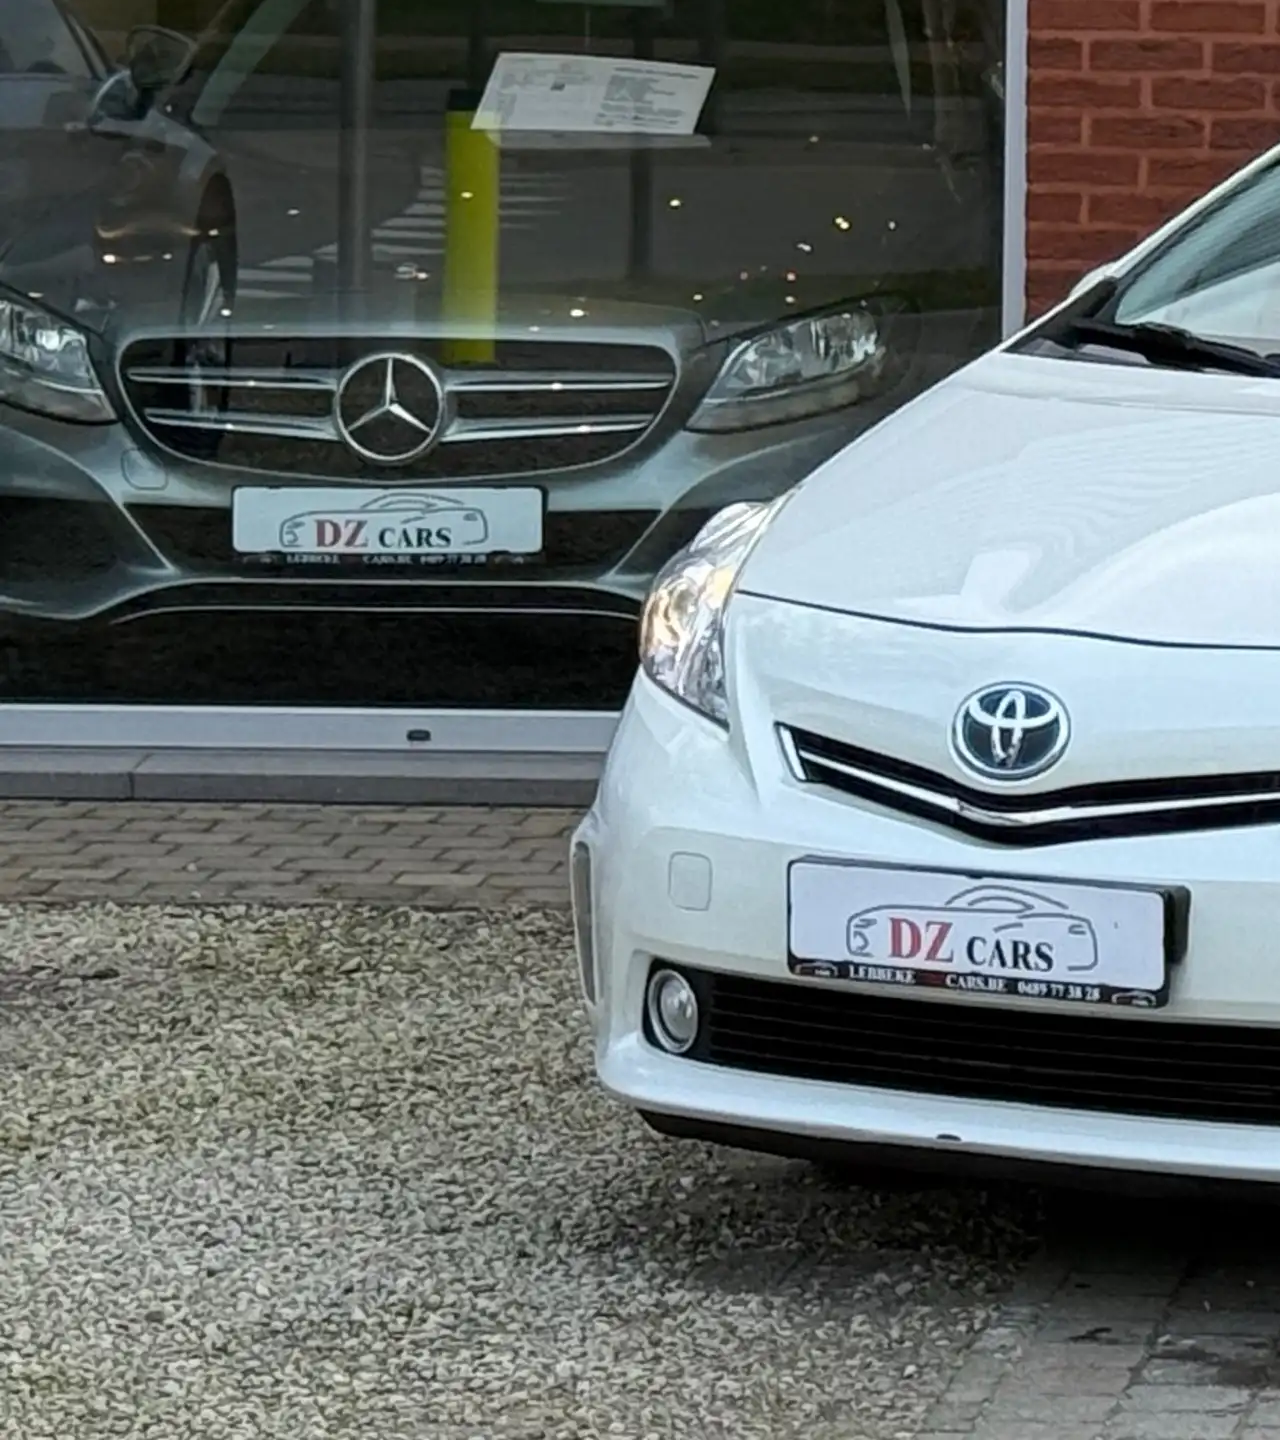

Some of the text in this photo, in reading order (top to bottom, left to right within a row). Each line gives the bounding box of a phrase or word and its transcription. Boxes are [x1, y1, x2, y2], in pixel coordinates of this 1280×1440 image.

[314, 519, 452, 549] DZ CARS
[887, 916, 1055, 973] DZ CARS
